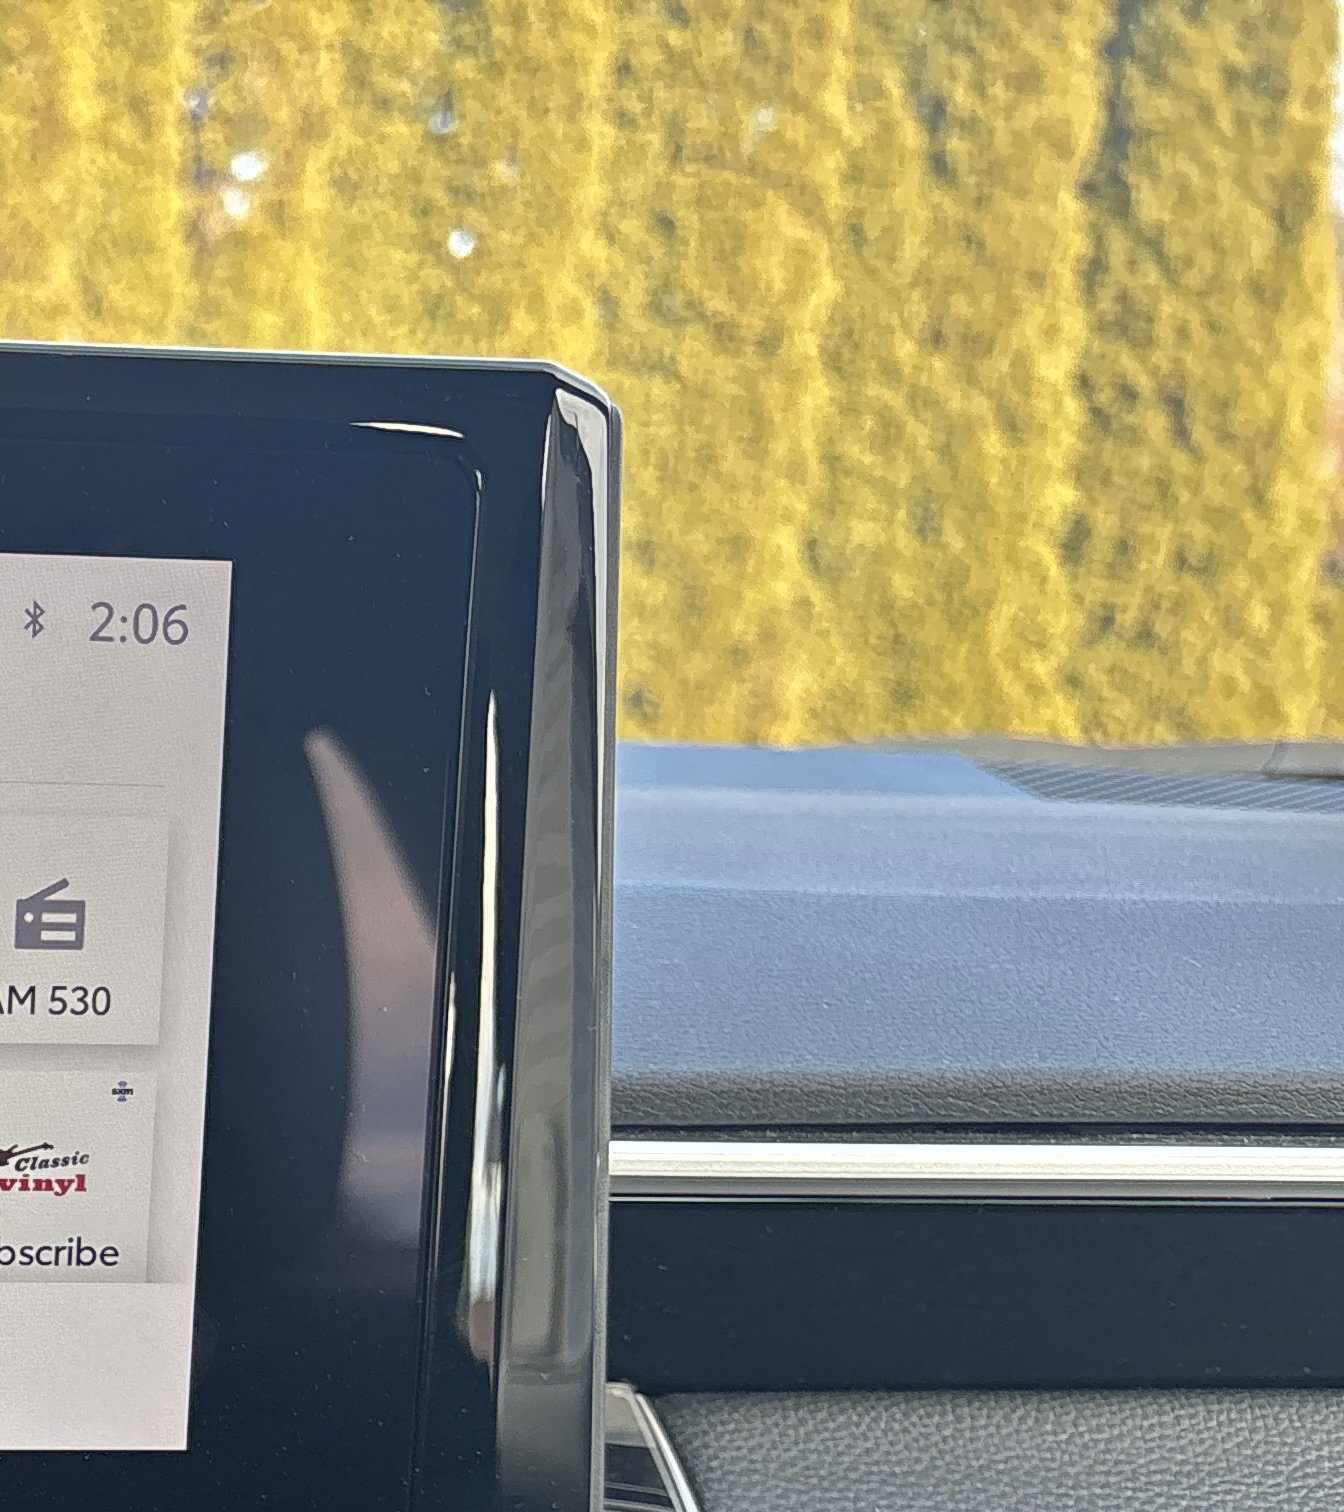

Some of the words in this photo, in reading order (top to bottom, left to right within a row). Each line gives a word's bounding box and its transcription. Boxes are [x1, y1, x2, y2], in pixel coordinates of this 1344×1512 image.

[89, 602, 189, 646] 2:06
[48, 985, 112, 1017] 530
[14, 1150, 90, 1172] Classic
